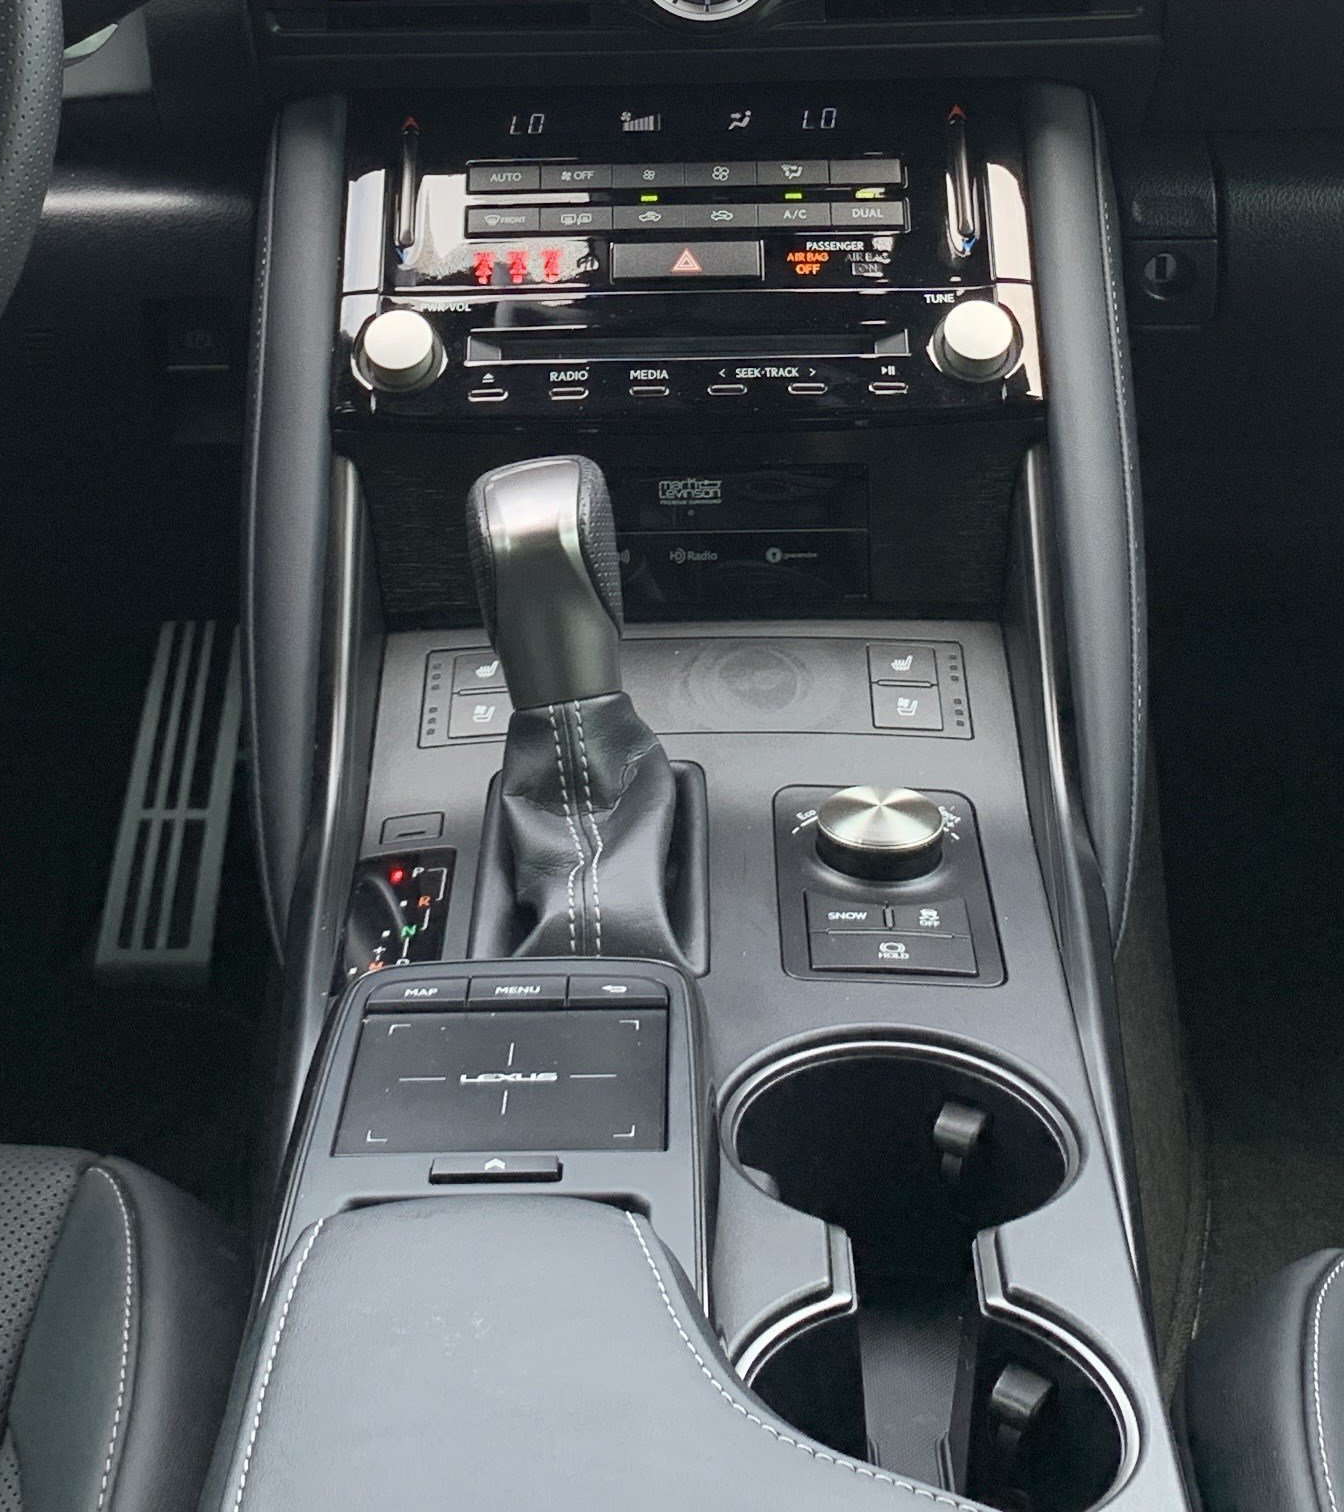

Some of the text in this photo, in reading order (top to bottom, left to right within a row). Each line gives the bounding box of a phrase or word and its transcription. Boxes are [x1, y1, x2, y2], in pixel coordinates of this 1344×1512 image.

[490, 172, 522, 183] AUTO
[574, 170, 595, 181] OFF
[783, 209, 807, 220] A/C
[852, 208, 884, 219] DUAL
[501, 216, 526, 226] FRONT
[806, 241, 864, 251] PASSENGER
[787, 252, 829, 262] AIR BAG
[845, 251, 864, 262] AIR
[796, 263, 820, 275] OFF
[924, 293, 955, 304] TUNE
[550, 371, 588, 382] RADIO
[630, 369, 669, 380] MEDIA
[687, 550, 718, 561] Radio
[796, 809, 817, 821] Eco
[412, 866, 425, 878] P
[417, 894, 431, 909] R
[827, 911, 868, 920] SNOW
[919, 919, 940, 927] OFF
[400, 924, 417, 938] N
[878, 951, 910, 960] HOLD
[404, 988, 438, 997] MAP
[495, 986, 541, 996] MENU
[460, 1072, 558, 1084] LEXUS
